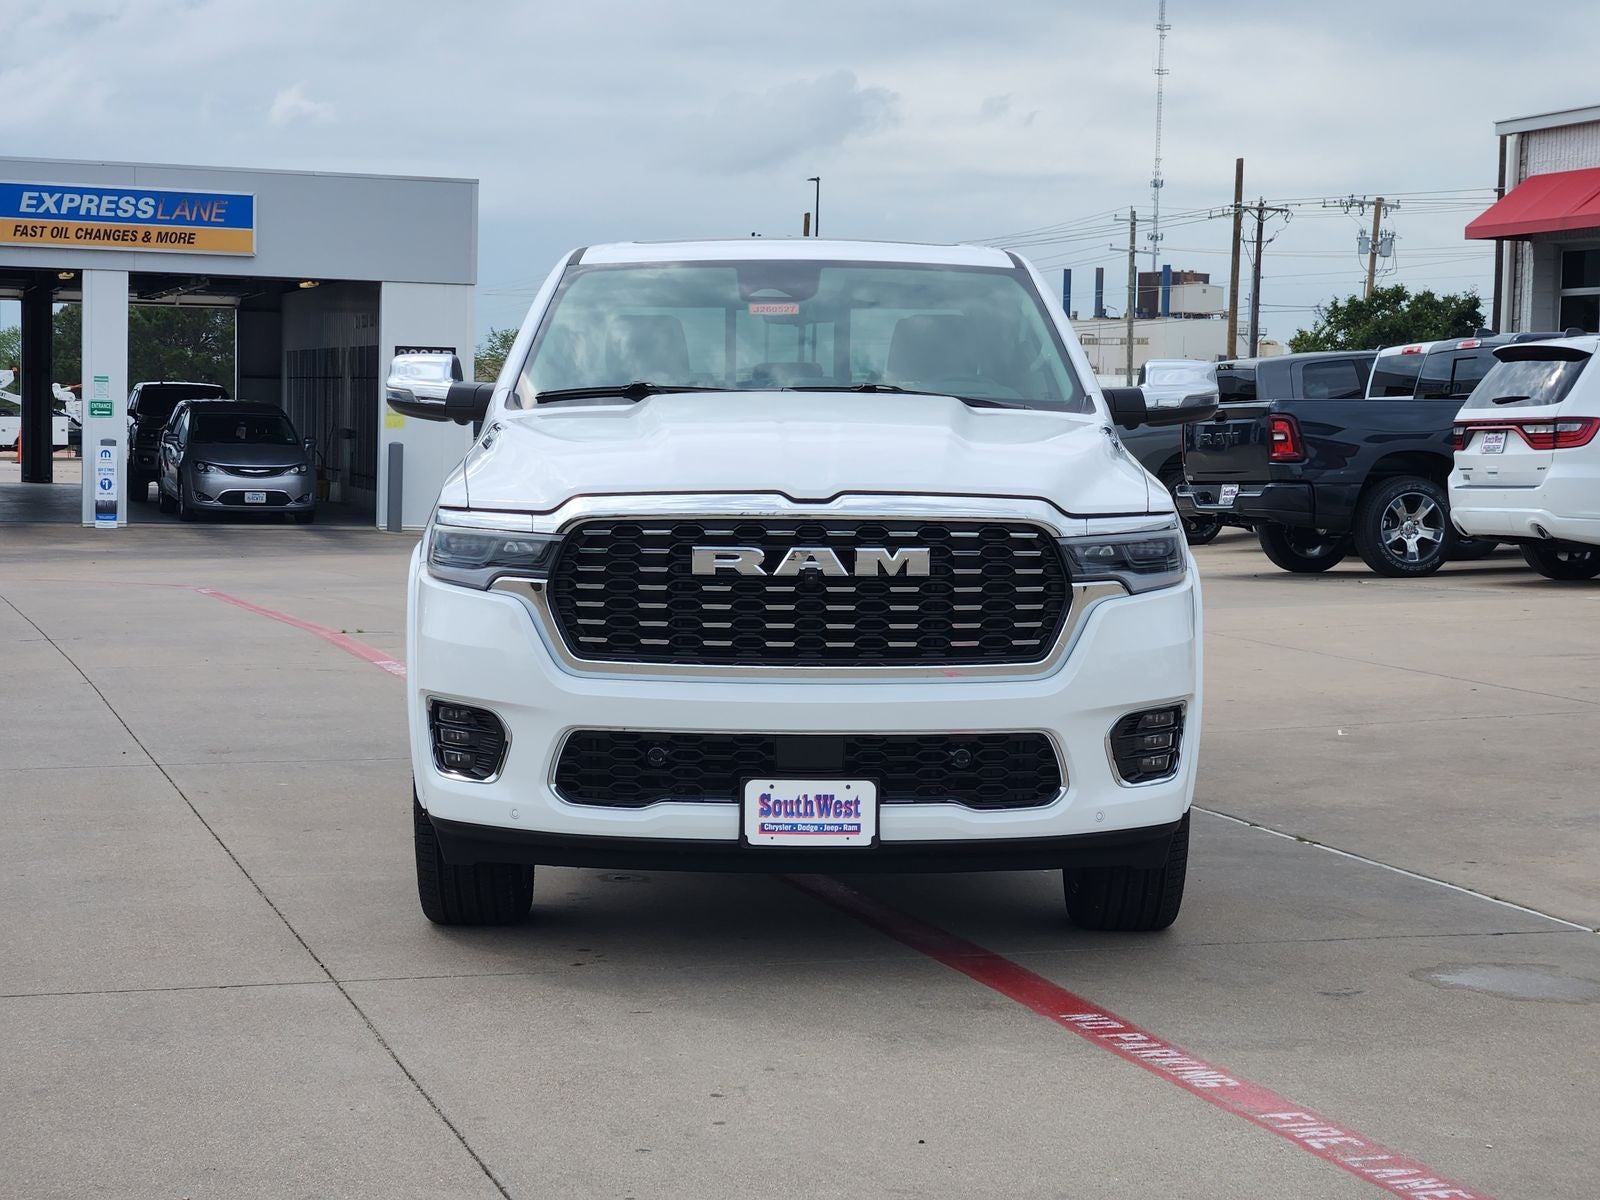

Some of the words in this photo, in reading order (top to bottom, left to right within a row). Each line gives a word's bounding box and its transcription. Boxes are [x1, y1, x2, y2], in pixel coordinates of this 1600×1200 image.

[13, 224, 47, 238] FAST
[50, 226, 70, 239] OIL
[75, 227, 138, 242] CHANGES
[141, 231, 152, 243] &
[155, 231, 196, 244] MORE
[692, 546, 930, 577] RAM
[759, 793, 861, 818] SouthWest
[764, 823, 792, 832] Chrysler
[797, 824, 818, 832] Dodge
[823, 825, 839, 833] Jeep
[1059, 1013, 1125, 1030] NO
[1097, 1032, 1241, 1088] PARKING
[1256, 1112, 1365, 1150] FIRE
[1344, 1155, 1475, 1200] LANE
